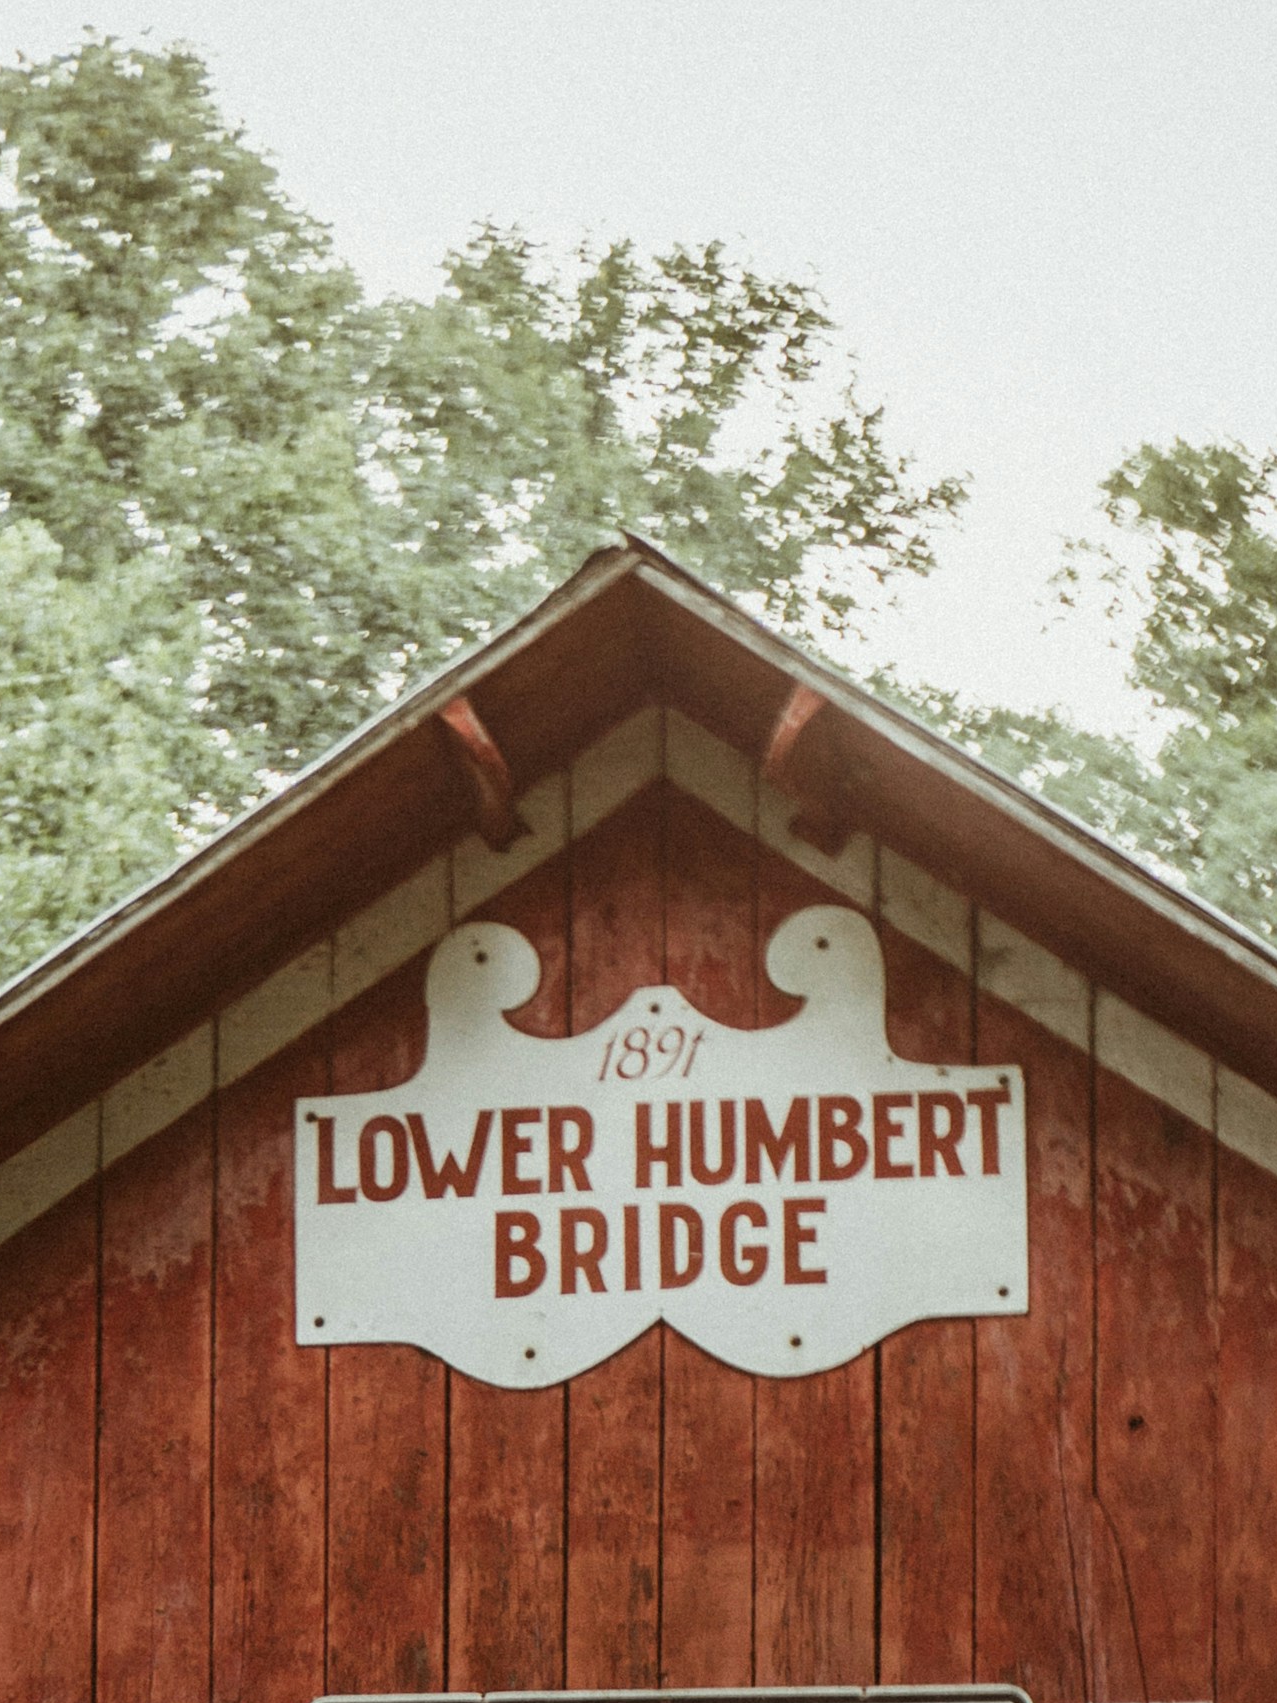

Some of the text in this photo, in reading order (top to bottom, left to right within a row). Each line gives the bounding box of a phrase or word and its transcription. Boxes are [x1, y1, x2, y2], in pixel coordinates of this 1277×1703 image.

[598, 1025, 707, 1082] 1891
[314, 1087, 1013, 1206] LOWER HUMBERT
[493, 1197, 828, 1299] BRIDGE
